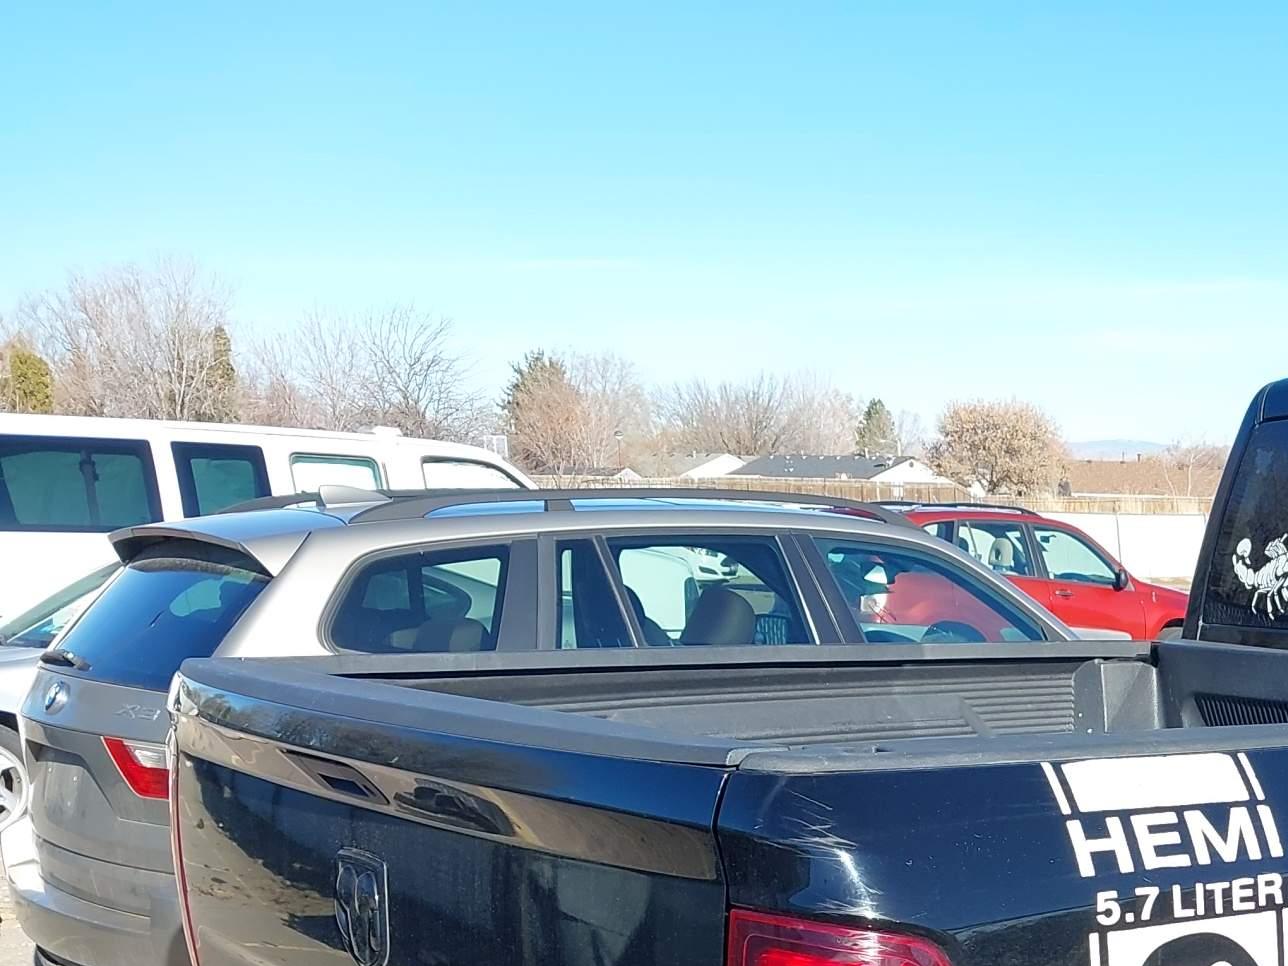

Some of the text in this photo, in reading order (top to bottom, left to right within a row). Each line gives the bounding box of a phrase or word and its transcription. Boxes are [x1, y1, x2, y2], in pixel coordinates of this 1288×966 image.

[1065, 804, 1285, 878] HEMI
[1094, 872, 1285, 927] 5.7 LITER
